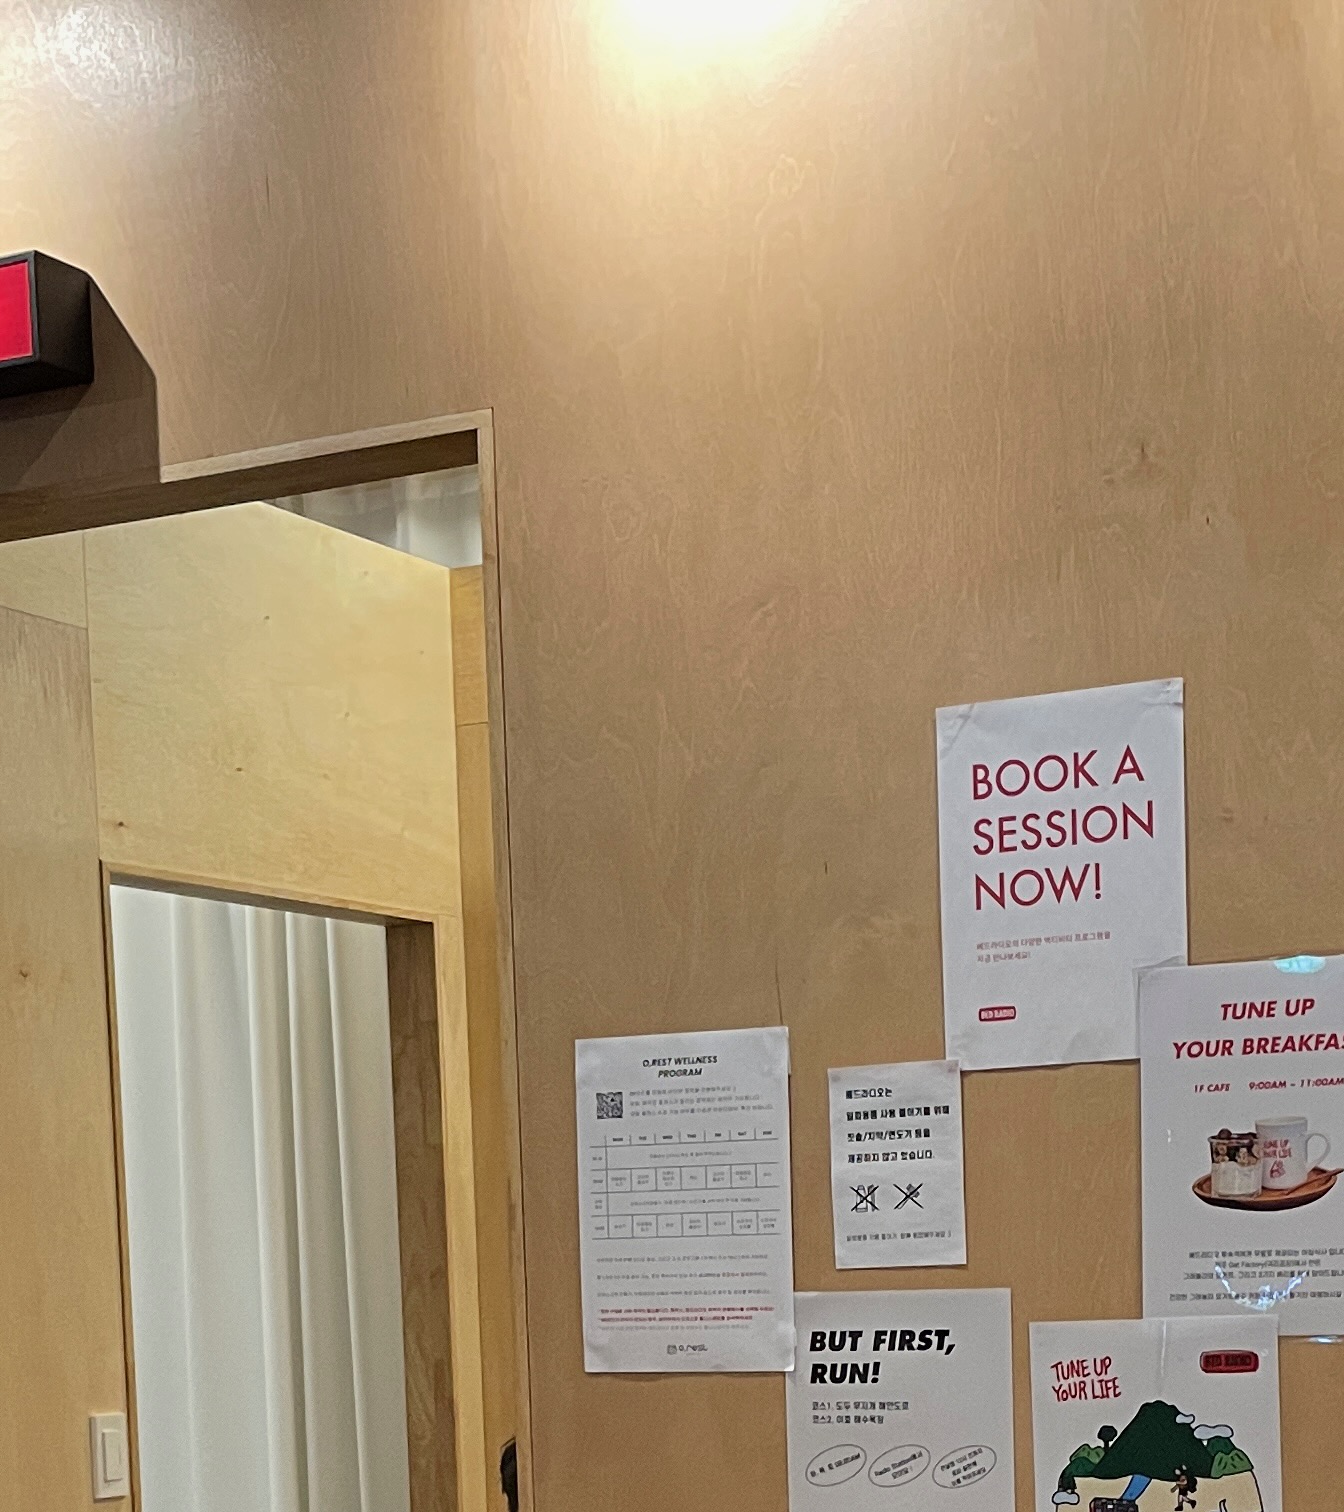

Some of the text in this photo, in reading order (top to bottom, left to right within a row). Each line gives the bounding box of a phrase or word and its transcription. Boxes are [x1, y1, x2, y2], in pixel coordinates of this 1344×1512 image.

[972, 744, 1145, 800] BOOK A
[973, 800, 1154, 856] SESSION
[975, 862, 1101, 910] NOW!
[1219, 998, 1315, 1021] TUNE UP
[1172, 1039, 1234, 1059] YOUR
[658, 1068, 702, 1078] PROGRAM
[1299, 1077, 1344, 1088] 11:00AM
[809, 1329, 956, 1355] BUT FIRST,
[810, 1362, 880, 1384] RUN!
[1051, 1356, 1112, 1383] TUNE UP
[1092, 1377, 1121, 1399] LIFE
